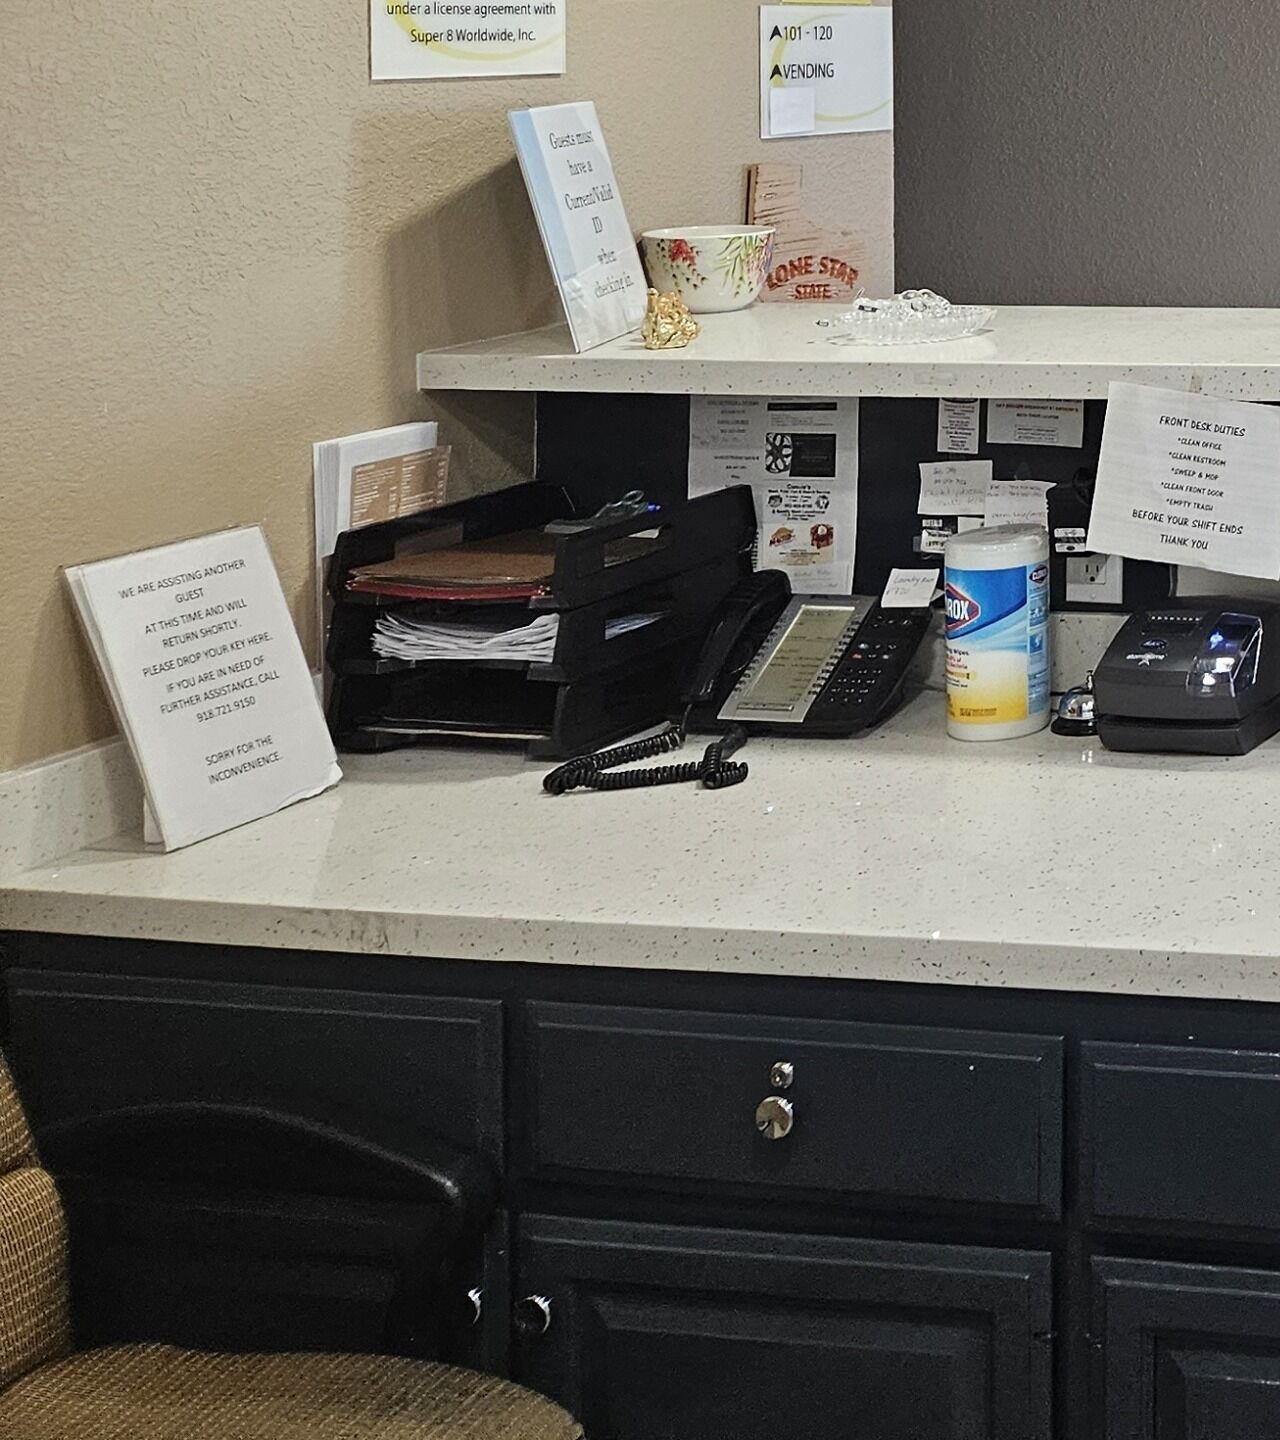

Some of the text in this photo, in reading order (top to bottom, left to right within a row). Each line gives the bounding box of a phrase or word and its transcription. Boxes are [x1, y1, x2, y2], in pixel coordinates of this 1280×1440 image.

[386, 1, 556, 18] under a license agreement with
[410, 28, 536, 45] Super 8 Worldwide, Inc.
[783, 25, 802, 40] 101
[813, 25, 832, 40] 120
[783, 62, 834, 79] VENDING
[768, 255, 859, 290] LONE STAR
[794, 283, 831, 299] STATE
[1159, 415, 1245, 436] FRONT DESK DUTIES
[1131, 508, 1243, 535] BEFORE YOUR SHIFT ENDS
[1159, 534, 1208, 549] THANK YOU
[118, 558, 246, 599] WE ARE ASSISTING ANOTHER
[175, 588, 204, 603] GUEST
[144, 598, 247, 634] AT THIS TIME AND WILL
[162, 620, 242, 648] RETURN SHORTLY.
[142, 661, 174, 677] PLEASE
[175, 653, 201, 669] DROP
[203, 646, 228, 661] YOUR
[229, 641, 246, 655] KEY
[166, 655, 264, 693] IF YOU ARE IN NEED OF
[160, 694, 201, 714] FURTHER
[257, 670, 279, 685] CALL
[205, 735, 272, 765] SORRY FOR THE
